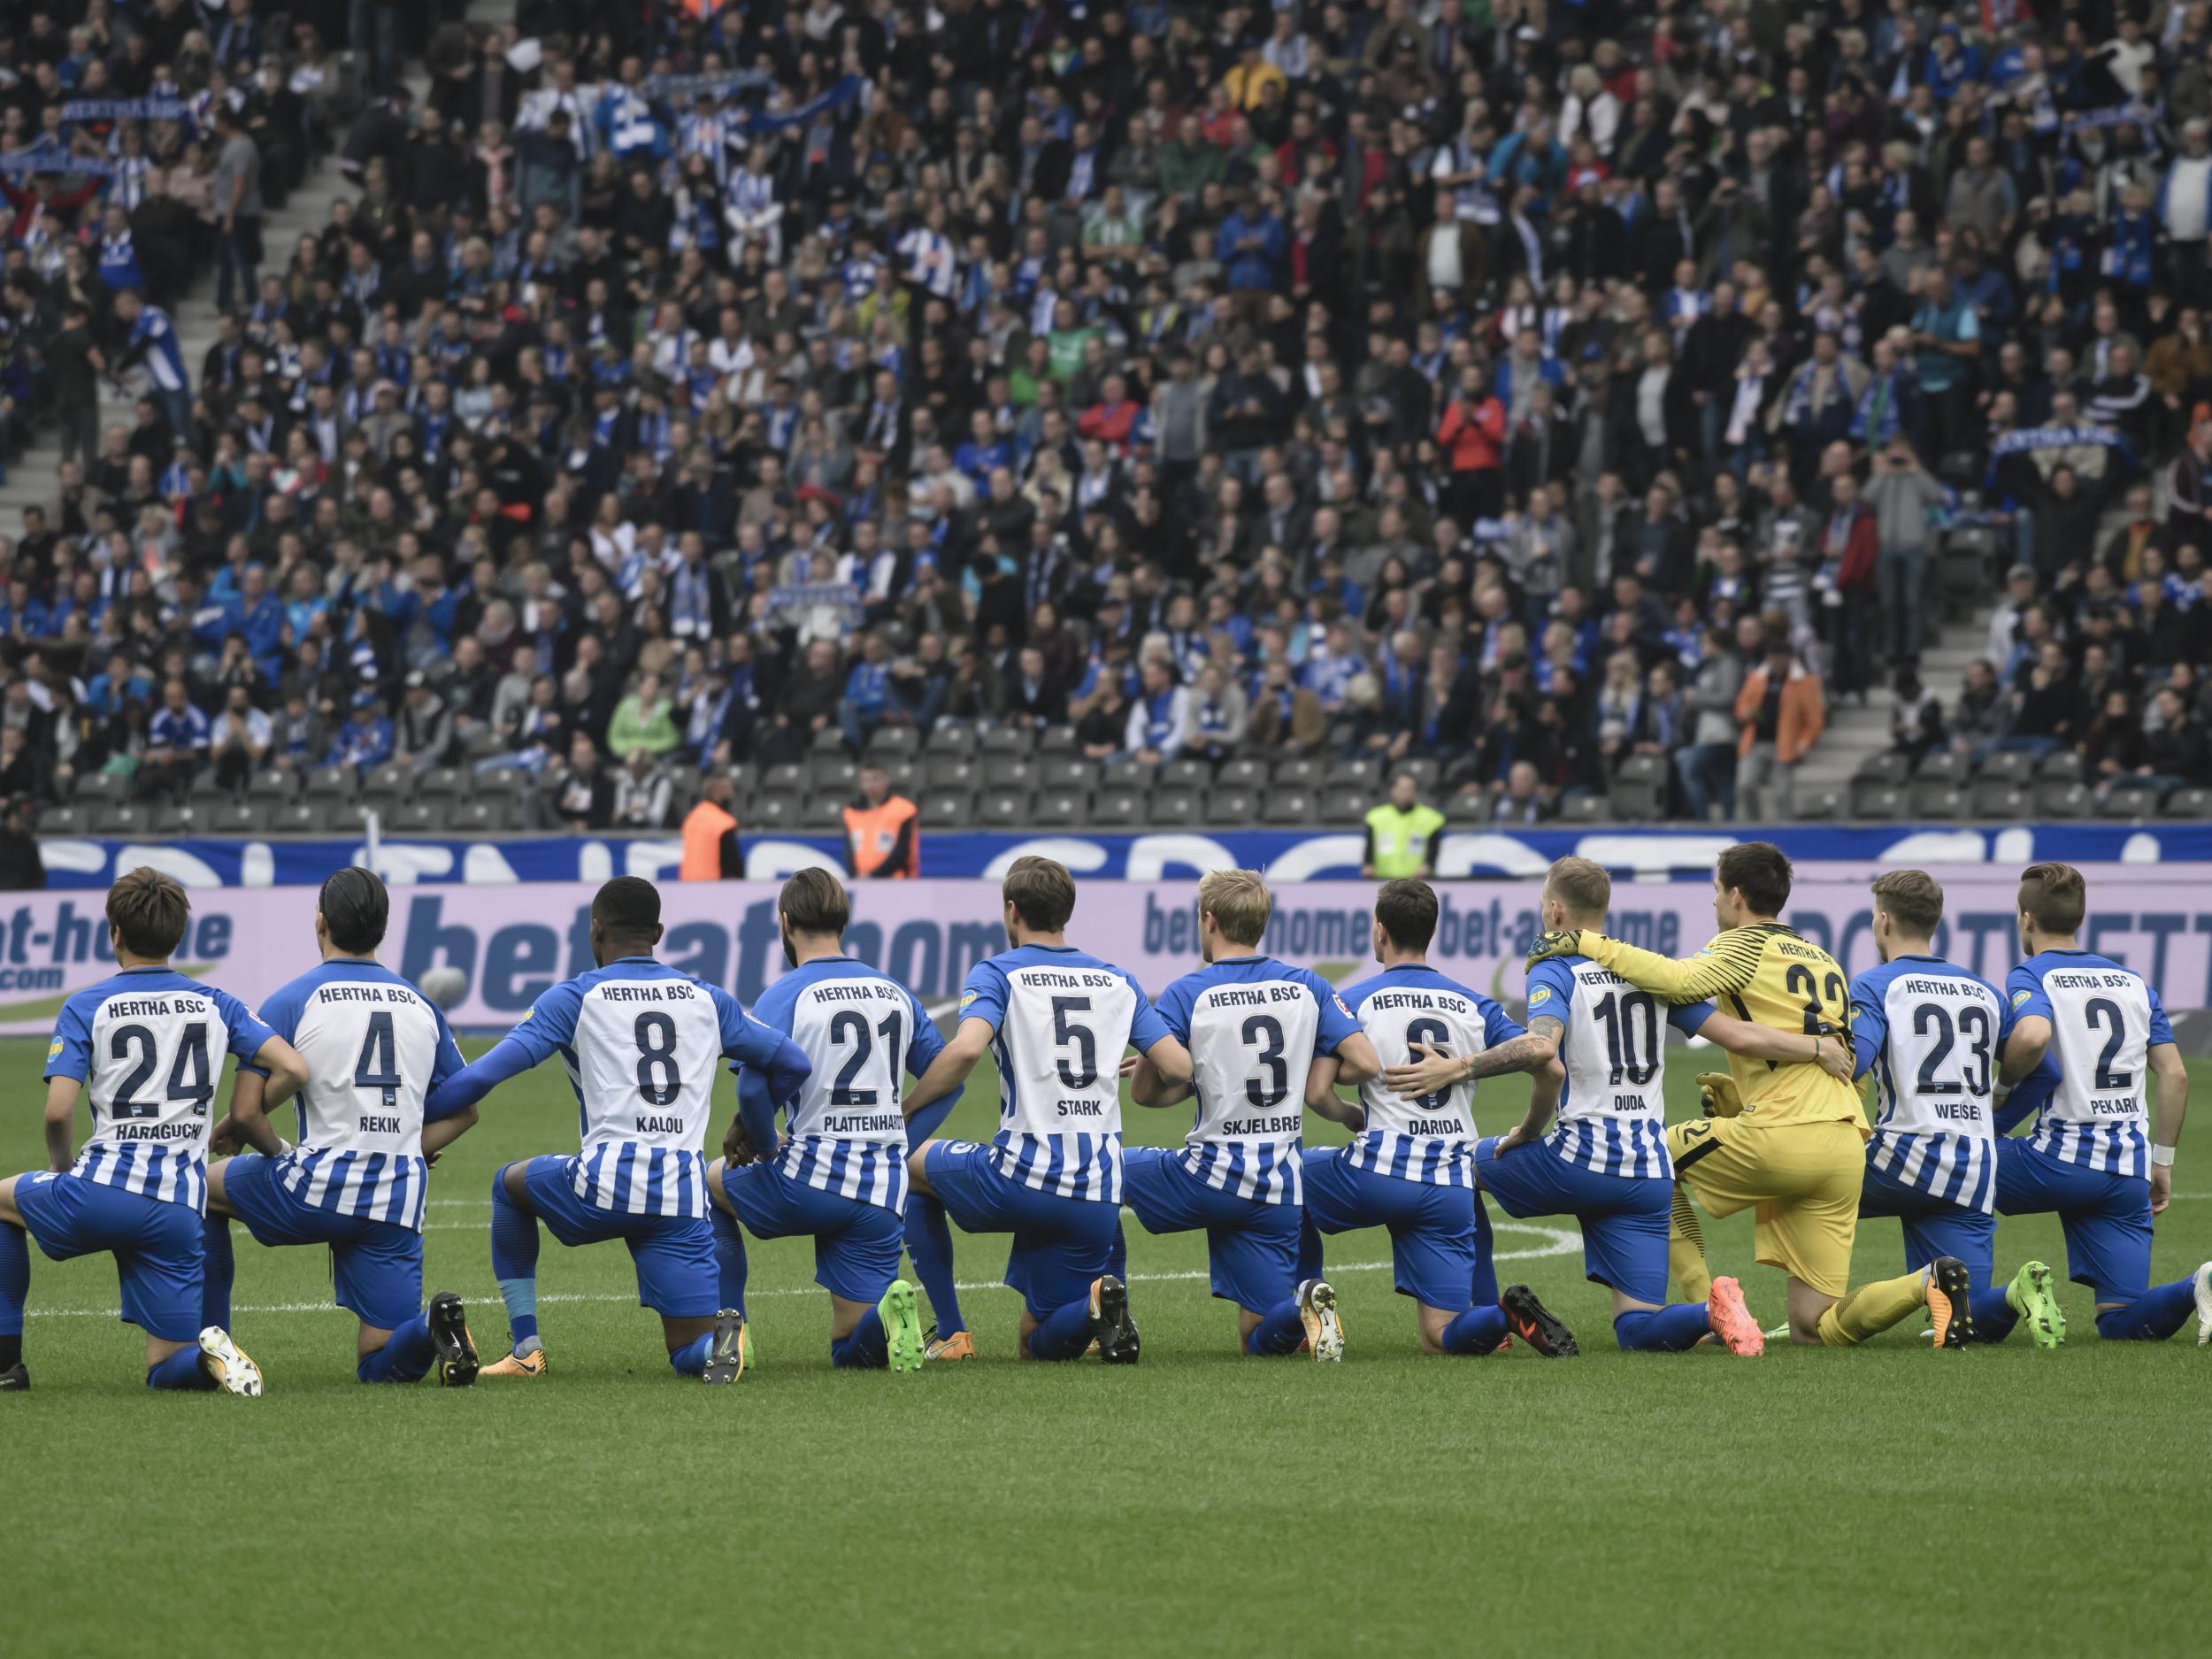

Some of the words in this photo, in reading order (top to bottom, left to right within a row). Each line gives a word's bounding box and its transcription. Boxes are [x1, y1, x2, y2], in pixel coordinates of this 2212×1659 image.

[1778, 941, 1820, 962] HERTHA
[1021, 973, 1079, 988] HERTHA
[1082, 974, 1113, 987] BSC
[1578, 970, 1630, 986] HERTH
[2052, 974, 2102, 989] HERTHA
[2105, 973, 2131, 988] BSC
[319, 987, 382, 1004] HERTHA
[388, 989, 417, 1005] BSC
[602, 987, 663, 1001] HERTHA
[666, 985, 695, 1000] BSC
[814, 987, 872, 1003] HERTHA
[874, 985, 899, 1002] BSC
[1209, 989, 1267, 1008] HERTHA
[1270, 985, 1302, 1002] BSC
[1906, 979, 1959, 996] HERTHA
[1962, 983, 1985, 1001] BSC
[109, 1001, 171, 1018] HERTHA
[174, 999, 206, 1014] BSC
[1372, 994, 1434, 1010] HERTHA
[1438, 996, 1467, 1014] BSC
[1052, 996, 1098, 1089] 5
[1594, 990, 1659, 1086] 10
[2085, 998, 2131, 1090] 2
[355, 1010, 402, 1106] 4
[634, 1011, 682, 1106] 8
[830, 1009, 902, 1106] 21
[1913, 1002, 1991, 1097] 23
[110, 1023, 214, 1119] 24
[1242, 1015, 1287, 1108] 3
[1406, 1018, 1453, 1111] 6
[1057, 1100, 1102, 1116] STARK
[1615, 1094, 1647, 1111] DUDA
[359, 1116, 401, 1133] REKIK
[636, 1117, 683, 1133] KALOU
[1223, 1115, 1302, 1136] SKJELBRE
[1409, 1118, 1464, 1136] DARIDA
